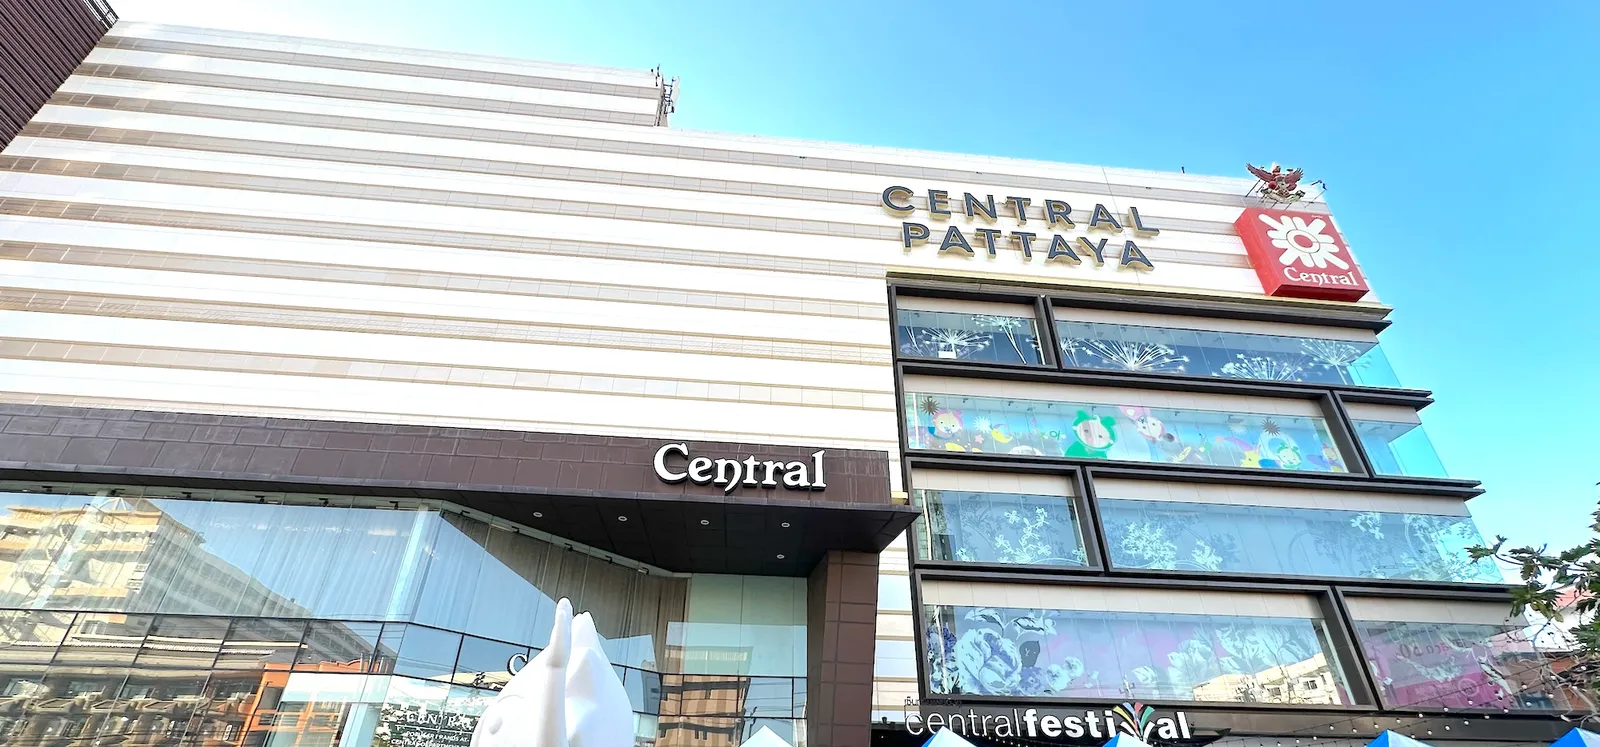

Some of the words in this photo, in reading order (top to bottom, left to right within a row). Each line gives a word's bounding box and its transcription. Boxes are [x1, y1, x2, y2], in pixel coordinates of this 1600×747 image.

[881, 184, 1160, 237] CENTRAL
[901, 220, 1155, 272] PATTAYA
[1283, 266, 1360, 286] Central
[653, 442, 827, 494] Central
